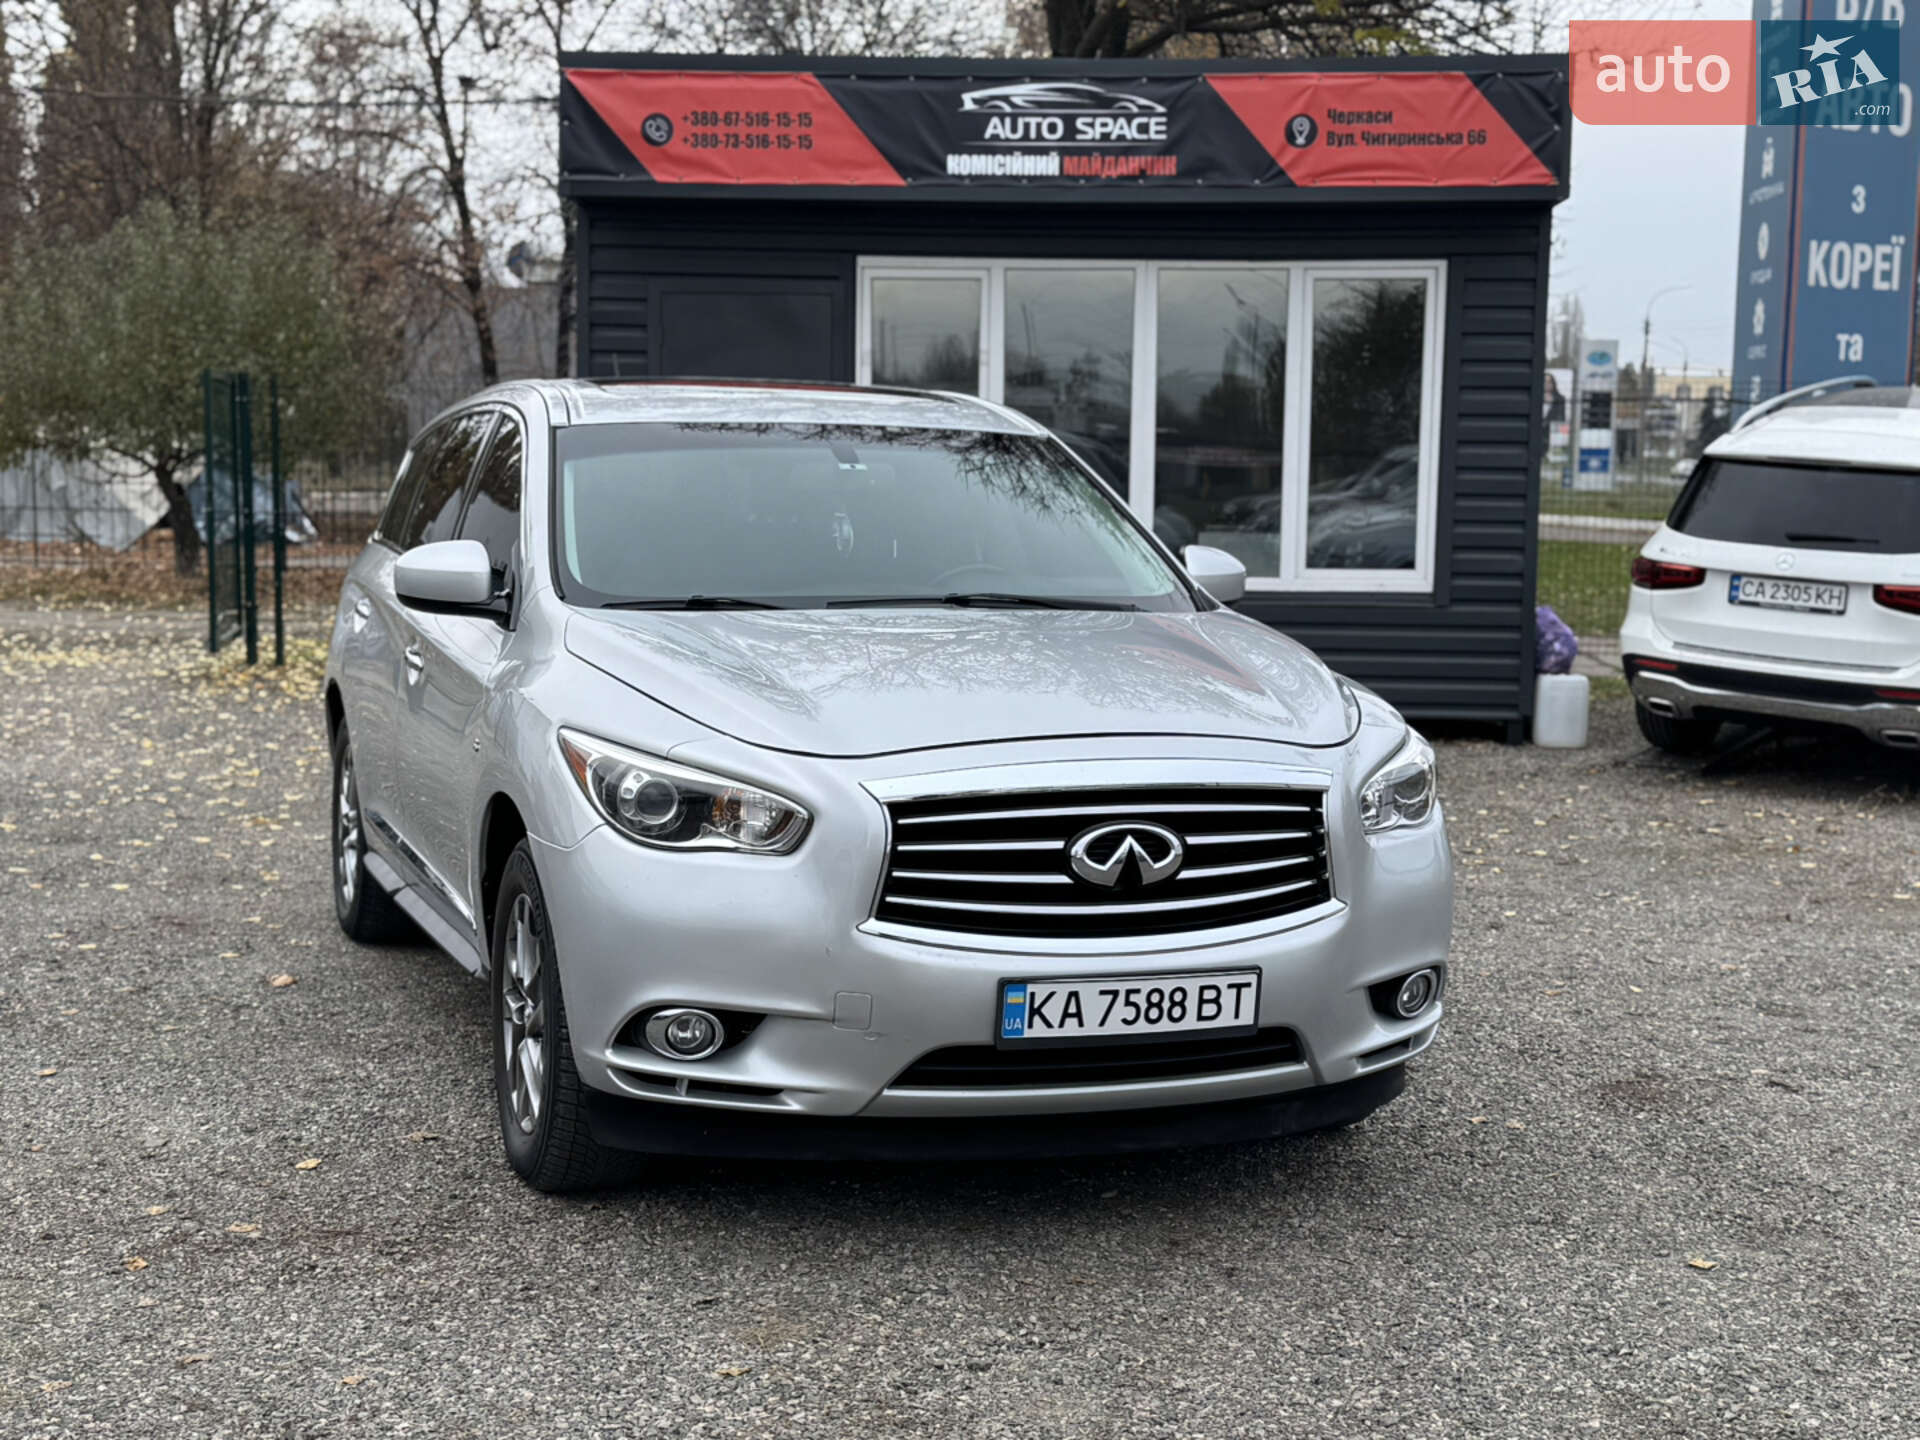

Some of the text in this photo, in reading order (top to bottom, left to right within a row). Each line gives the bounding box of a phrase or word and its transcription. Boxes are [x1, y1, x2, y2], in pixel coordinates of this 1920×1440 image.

[682, 111, 813, 128] +380-67-516-15-15
[984, 116, 1168, 140] AUTO SPACE
[1327, 109, 1393, 125] Черкаси
[682, 133, 813, 150] +380-73-516-15-15
[1361, 131, 1463, 147] Чигиринська
[1467, 130, 1487, 145] 66
[946, 151, 1060, 176] КОМІСІЙНИЙ
[1807, 235, 1905, 291] КОРЕЇ
[1836, 333, 1863, 362] та
[1741, 580, 1843, 606] CA 2305 KH
[1027, 982, 1252, 1029] KA 7588 BT
[1004, 1017, 1022, 1030] UA
